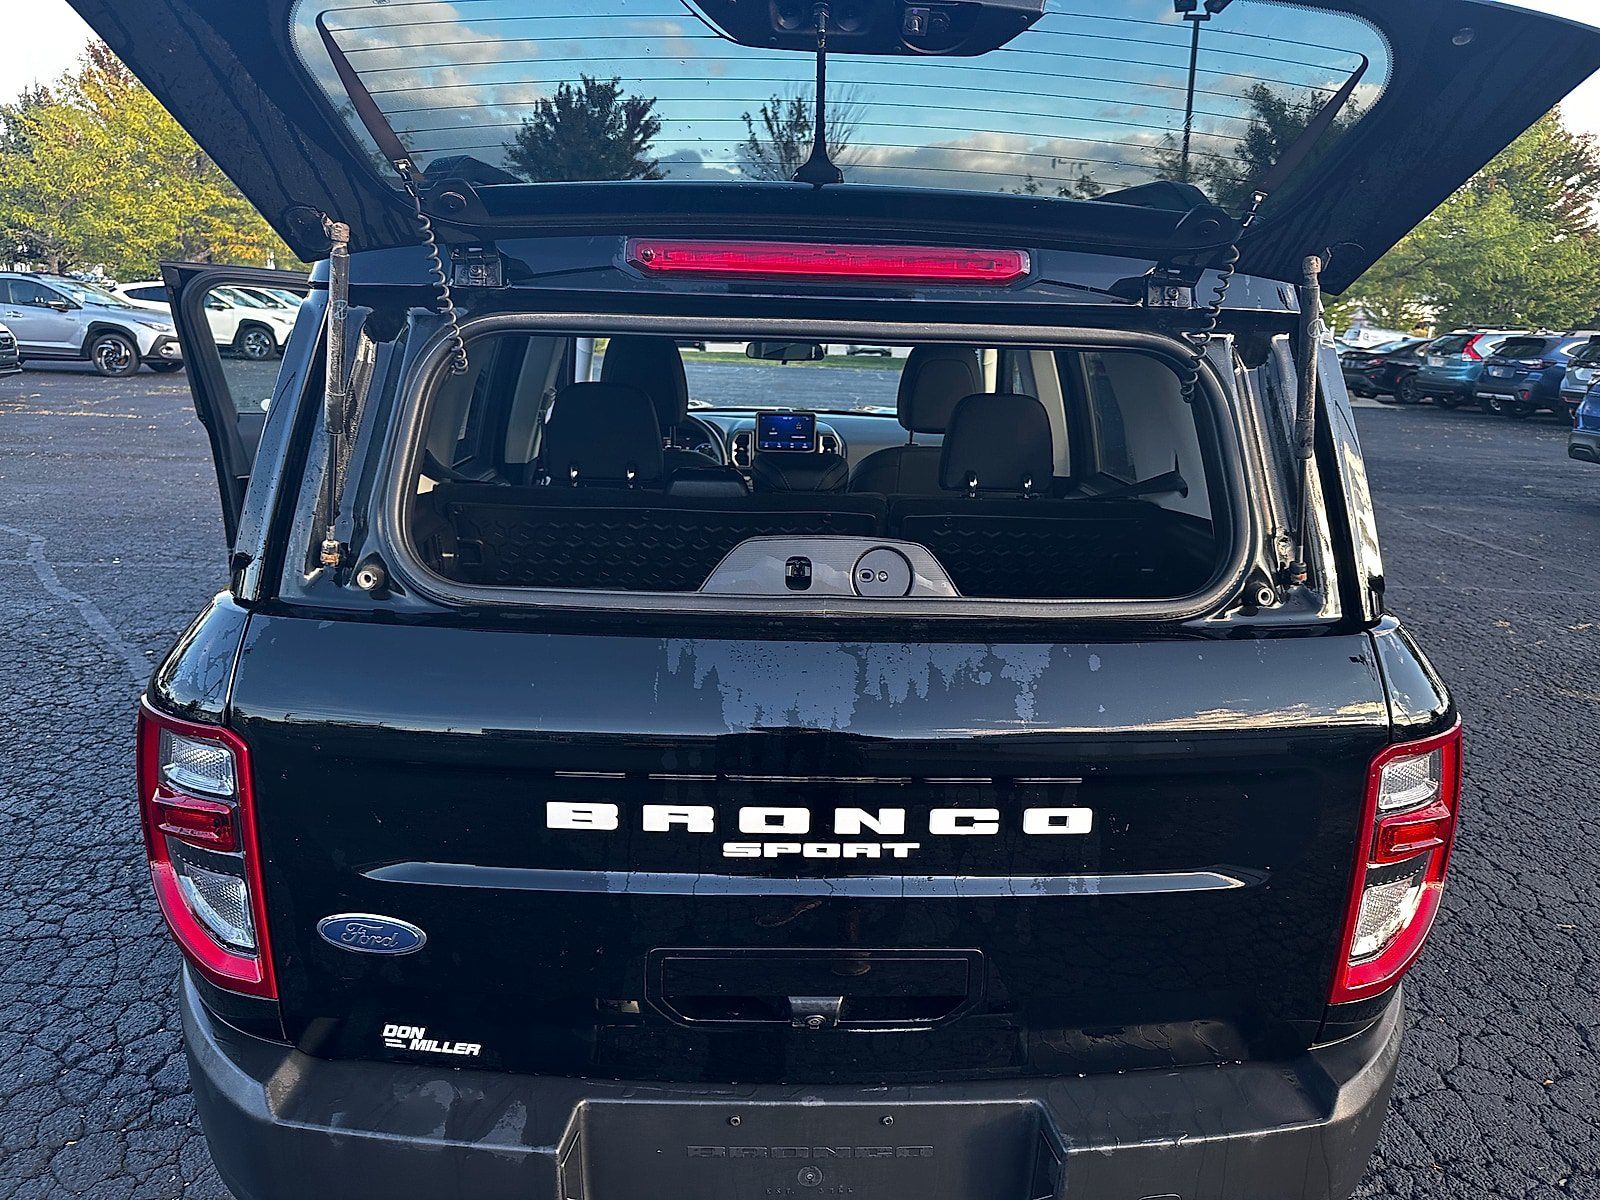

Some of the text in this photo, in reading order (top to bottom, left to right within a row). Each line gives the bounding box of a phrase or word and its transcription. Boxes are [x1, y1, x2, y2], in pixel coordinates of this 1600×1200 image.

[546, 801, 1094, 835] BRONCO
[722, 842, 921, 858] SPORT
[341, 922, 399, 948] Ford
[382, 1024, 426, 1040] DON
[408, 1038, 482, 1056] MILLER
[687, 1145, 934, 1158] BRONCO
